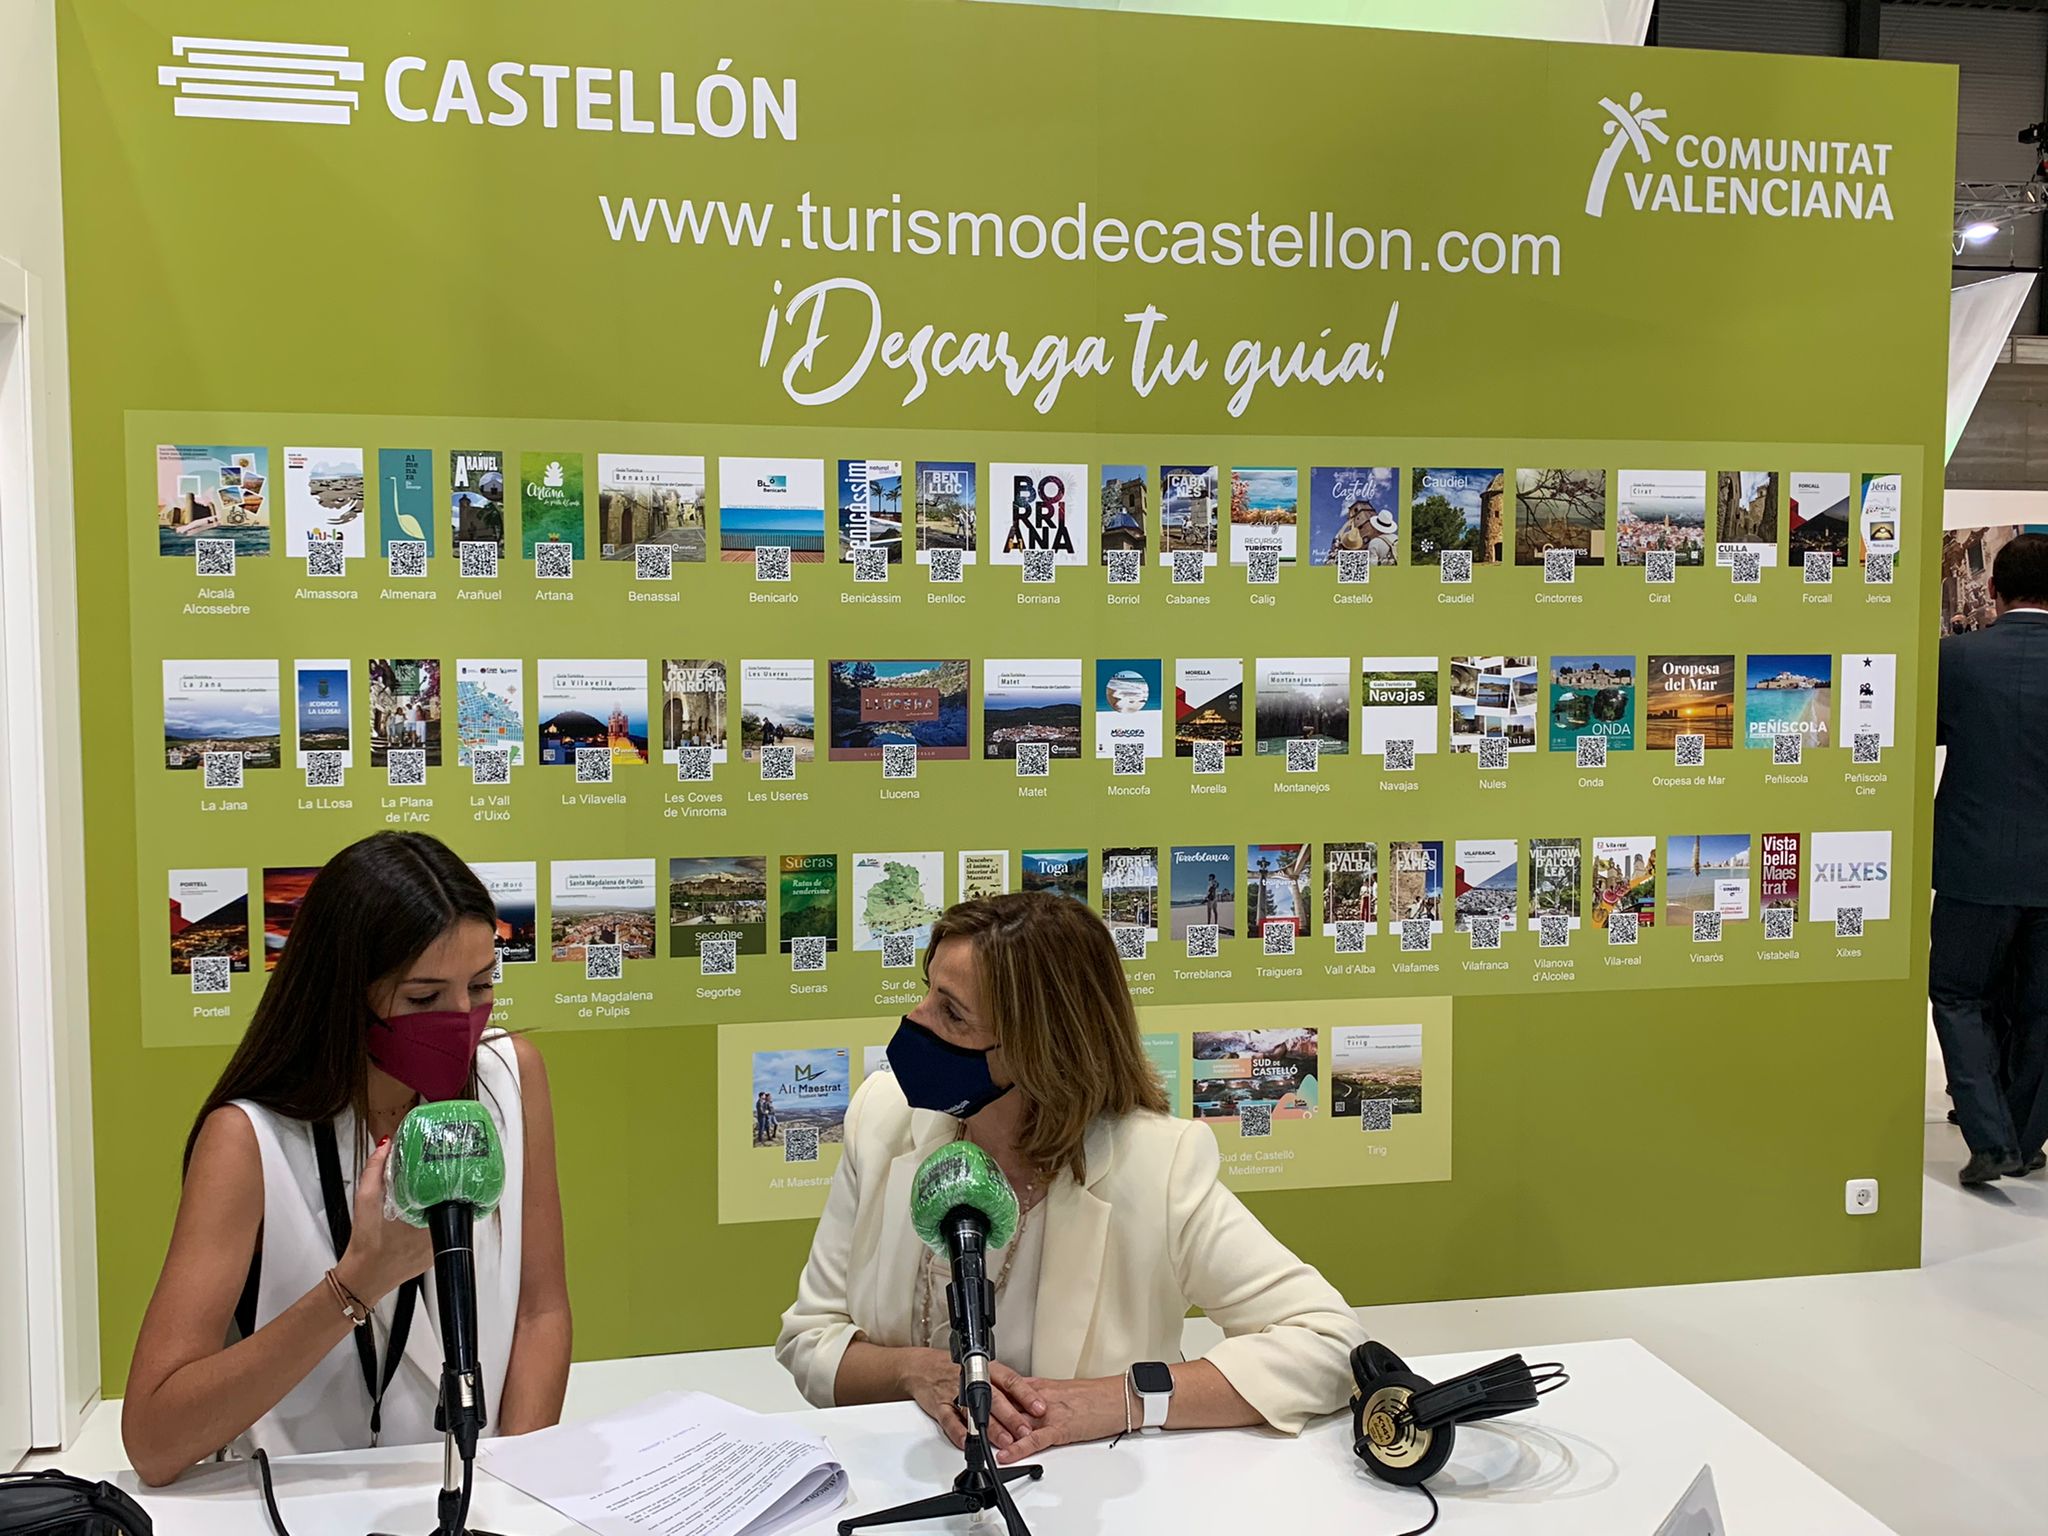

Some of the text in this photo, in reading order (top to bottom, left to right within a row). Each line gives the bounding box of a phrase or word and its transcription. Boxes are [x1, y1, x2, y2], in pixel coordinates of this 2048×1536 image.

[384, 56, 798, 141] CASTELLÓN
[1676, 134, 1893, 176] COMUNITAT
[1624, 172, 1894, 221] VALENCIANA
[599, 192, 1561, 276] www.turismodecastellon.com
[760, 277, 1399, 418] ¡Descarga tu guía!
[616, 474, 660, 482] Benassal
[932, 473, 959, 484] BEN
[1171, 476, 1206, 487] CABA
[1422, 475, 1468, 488] Caudiel
[929, 483, 962, 494] LLOC
[1870, 482, 1896, 491] Jérica
[1177, 487, 1201, 498] NES
[295, 589, 358, 599] Almassora
[380, 589, 436, 599] Almenara
[457, 590, 501, 600] Arañuel
[536, 591, 573, 600] Artana
[629, 591, 680, 602] Benassal
[927, 594, 965, 604] Benlloc
[1018, 594, 1060, 604] Borriana
[1334, 593, 1373, 604] Castelló
[1438, 594, 1474, 604] Caudiel
[1535, 593, 1582, 603] Cinctorres
[1649, 593, 1670, 603] Cirat
[1734, 594, 1757, 603] Culla
[1803, 594, 1832, 603] Forcall
[1866, 594, 1891, 603] Jerica
[1107, 595, 1140, 604] Borriol
[1166, 595, 1210, 604] Cabanes
[1250, 595, 1275, 605] Calig
[183, 604, 250, 614] Alcossebre
[1662, 662, 1720, 676] Oropesa
[1665, 678, 1717, 691] del Mar
[1369, 688, 1425, 704] Navajas
[1592, 723, 1630, 735] ONDA
[1750, 719, 1827, 733] PEÑÍSCOLA
[1479, 780, 1507, 789] Nules
[1579, 778, 1604, 787] Onda
[1653, 776, 1726, 786] Oropesa de Mar
[1108, 786, 1150, 795] Moncofa
[1191, 785, 1226, 794] Morella
[1274, 783, 1330, 793] Montanejos
[1380, 781, 1418, 792] Navajas
[1856, 786, 1875, 795] Cine
[748, 791, 808, 801] Les Useres
[880, 789, 920, 799] Llucena
[1019, 787, 1047, 797] Matet
[381, 797, 433, 808] La Plana
[471, 795, 510, 806] La Vall
[562, 794, 626, 804] La Vilavella
[665, 793, 723, 803] Les Coves
[201, 800, 248, 811] La Jana
[298, 799, 353, 809] La LLosa
[386, 812, 430, 822] de l'Arc
[664, 808, 727, 817] de Vinroma
[1763, 837, 1797, 851] Vista
[1174, 852, 1231, 864] Torreblanca
[1335, 853, 1366, 862] VALL
[1403, 852, 1429, 861] VILA
[1530, 849, 1581, 858] VILANOVA
[1764, 852, 1796, 865] bella
[785, 856, 833, 869] Sueras
[1039, 861, 1068, 876] Toga
[1545, 867, 1565, 876] LEA
[1763, 867, 1796, 880] Maes
[1815, 862, 1888, 882] XILXES
[1763, 881, 1787, 895] trat
[1757, 951, 1800, 960] Vistabella
[1836, 949, 1862, 957] Xilxes
[1462, 961, 1509, 971] Vilafranca
[1534, 959, 1574, 969] Vilanova
[1604, 956, 1642, 966] Vila-real
[1256, 967, 1302, 978] Traiguera
[1325, 965, 1376, 975] Vall d'Alba
[1392, 963, 1439, 973] Vilafames
[1174, 970, 1232, 979] Torreblanca
[1533, 971, 1575, 981] d'Alcolea
[790, 984, 828, 994] Sueras
[882, 979, 916, 990] Sur de
[555, 991, 653, 1004] Santa Magdalena
[697, 988, 741, 1000] Segorbe
[874, 993, 923, 1004] Castellón
[194, 1007, 230, 1017] Portell
[579, 1007, 630, 1018] de Pulpis
[1253, 1059, 1271, 1068] SUD
[1253, 1064, 1298, 1076] CASTELLÓ
[779, 1083, 841, 1095] Alt Maestrat
[1368, 1145, 1387, 1156] Tirig
[1219, 1152, 1237, 1161] Sud
[1240, 1152, 1252, 1161] de
[1229, 1165, 1283, 1175] Mediterrani
[769, 1179, 784, 1188] Alt
